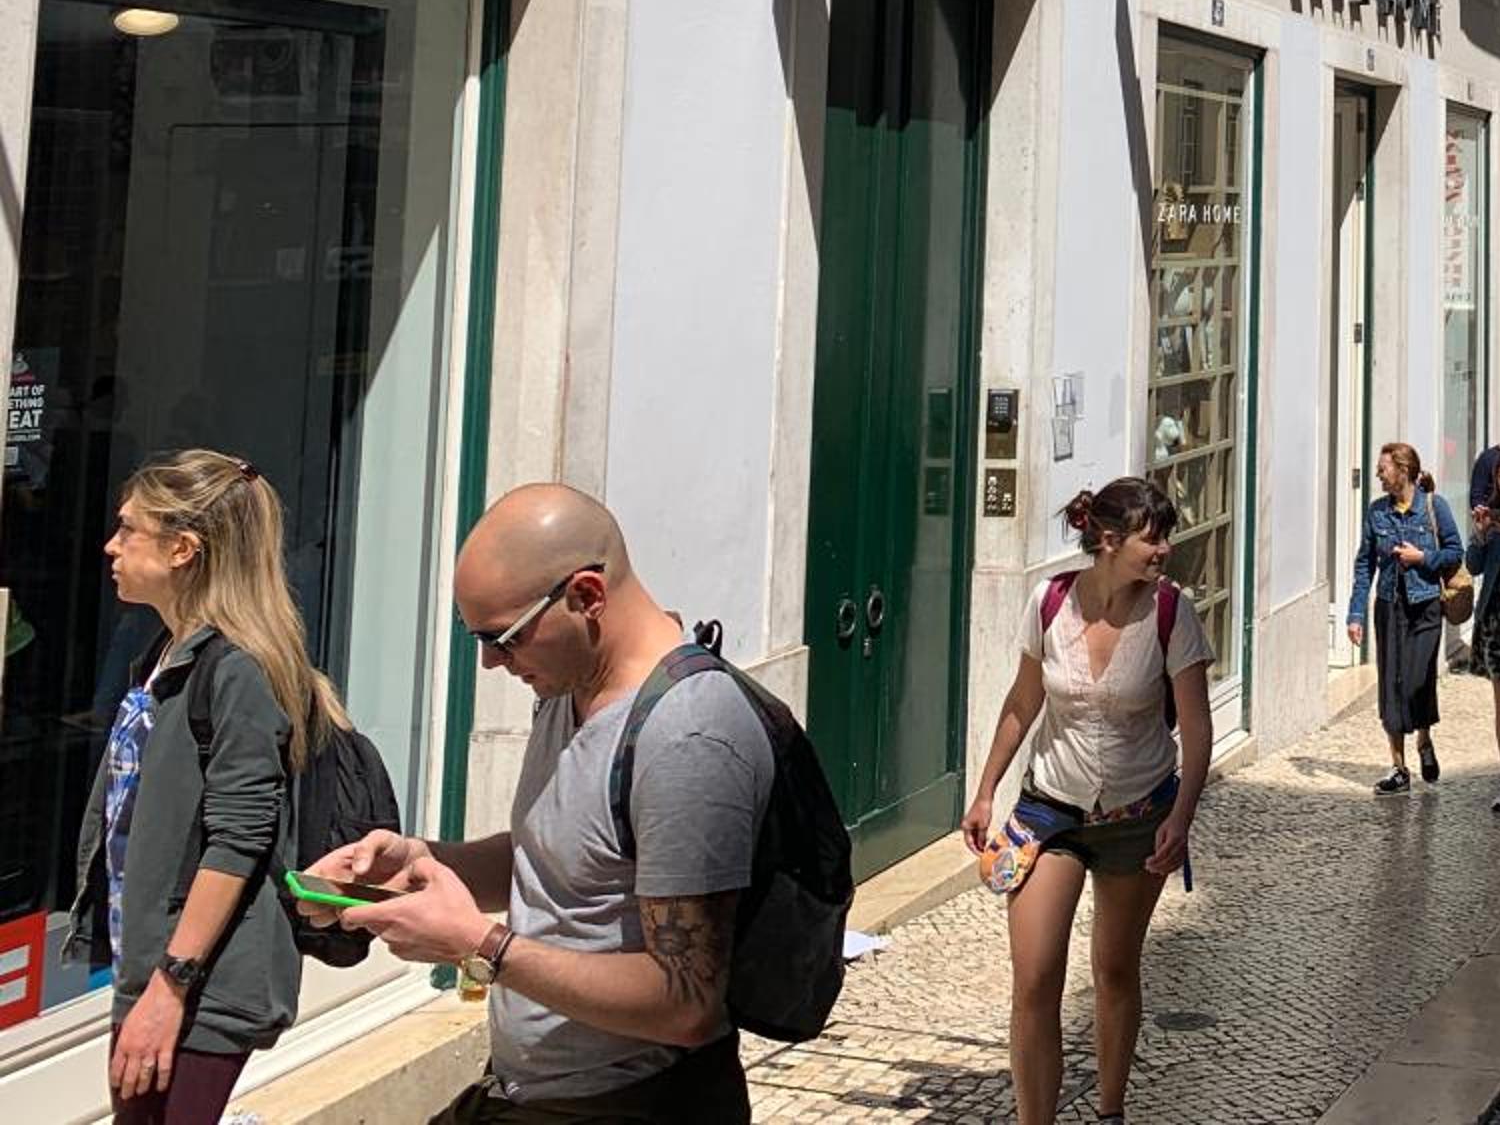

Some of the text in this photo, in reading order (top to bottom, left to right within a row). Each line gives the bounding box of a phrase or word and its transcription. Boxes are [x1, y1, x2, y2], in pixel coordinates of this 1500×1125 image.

[1157, 203, 1241, 224] ZARA HOME
[10, 384, 45, 397] ART OF
[9, 409, 43, 428] EAT
